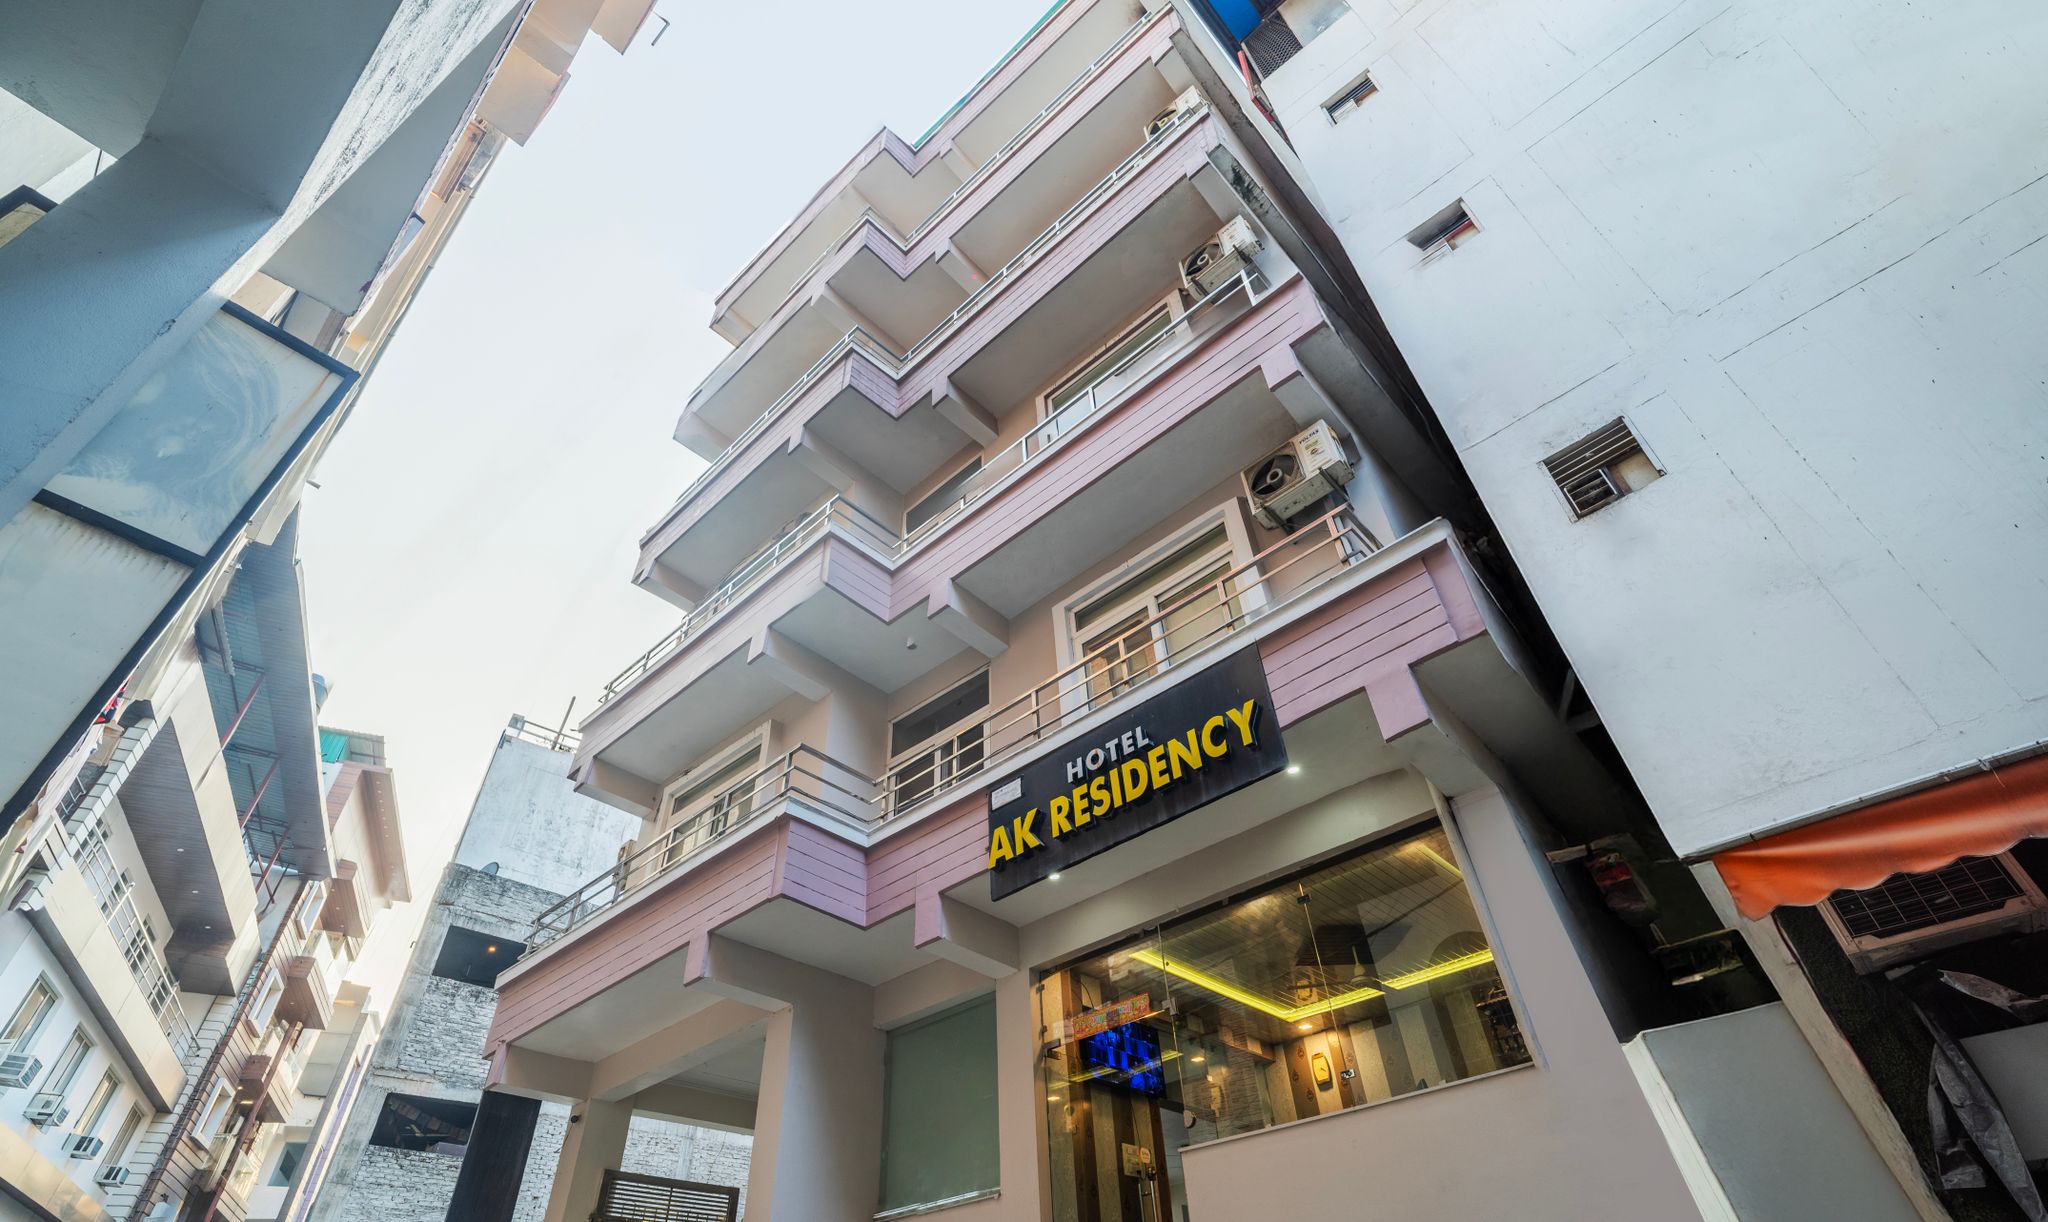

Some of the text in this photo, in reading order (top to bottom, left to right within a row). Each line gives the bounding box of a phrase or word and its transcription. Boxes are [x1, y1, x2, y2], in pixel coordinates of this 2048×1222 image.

[988, 698, 1256, 870] AK RESIDENCY
[1066, 726, 1149, 783] HOTEL
